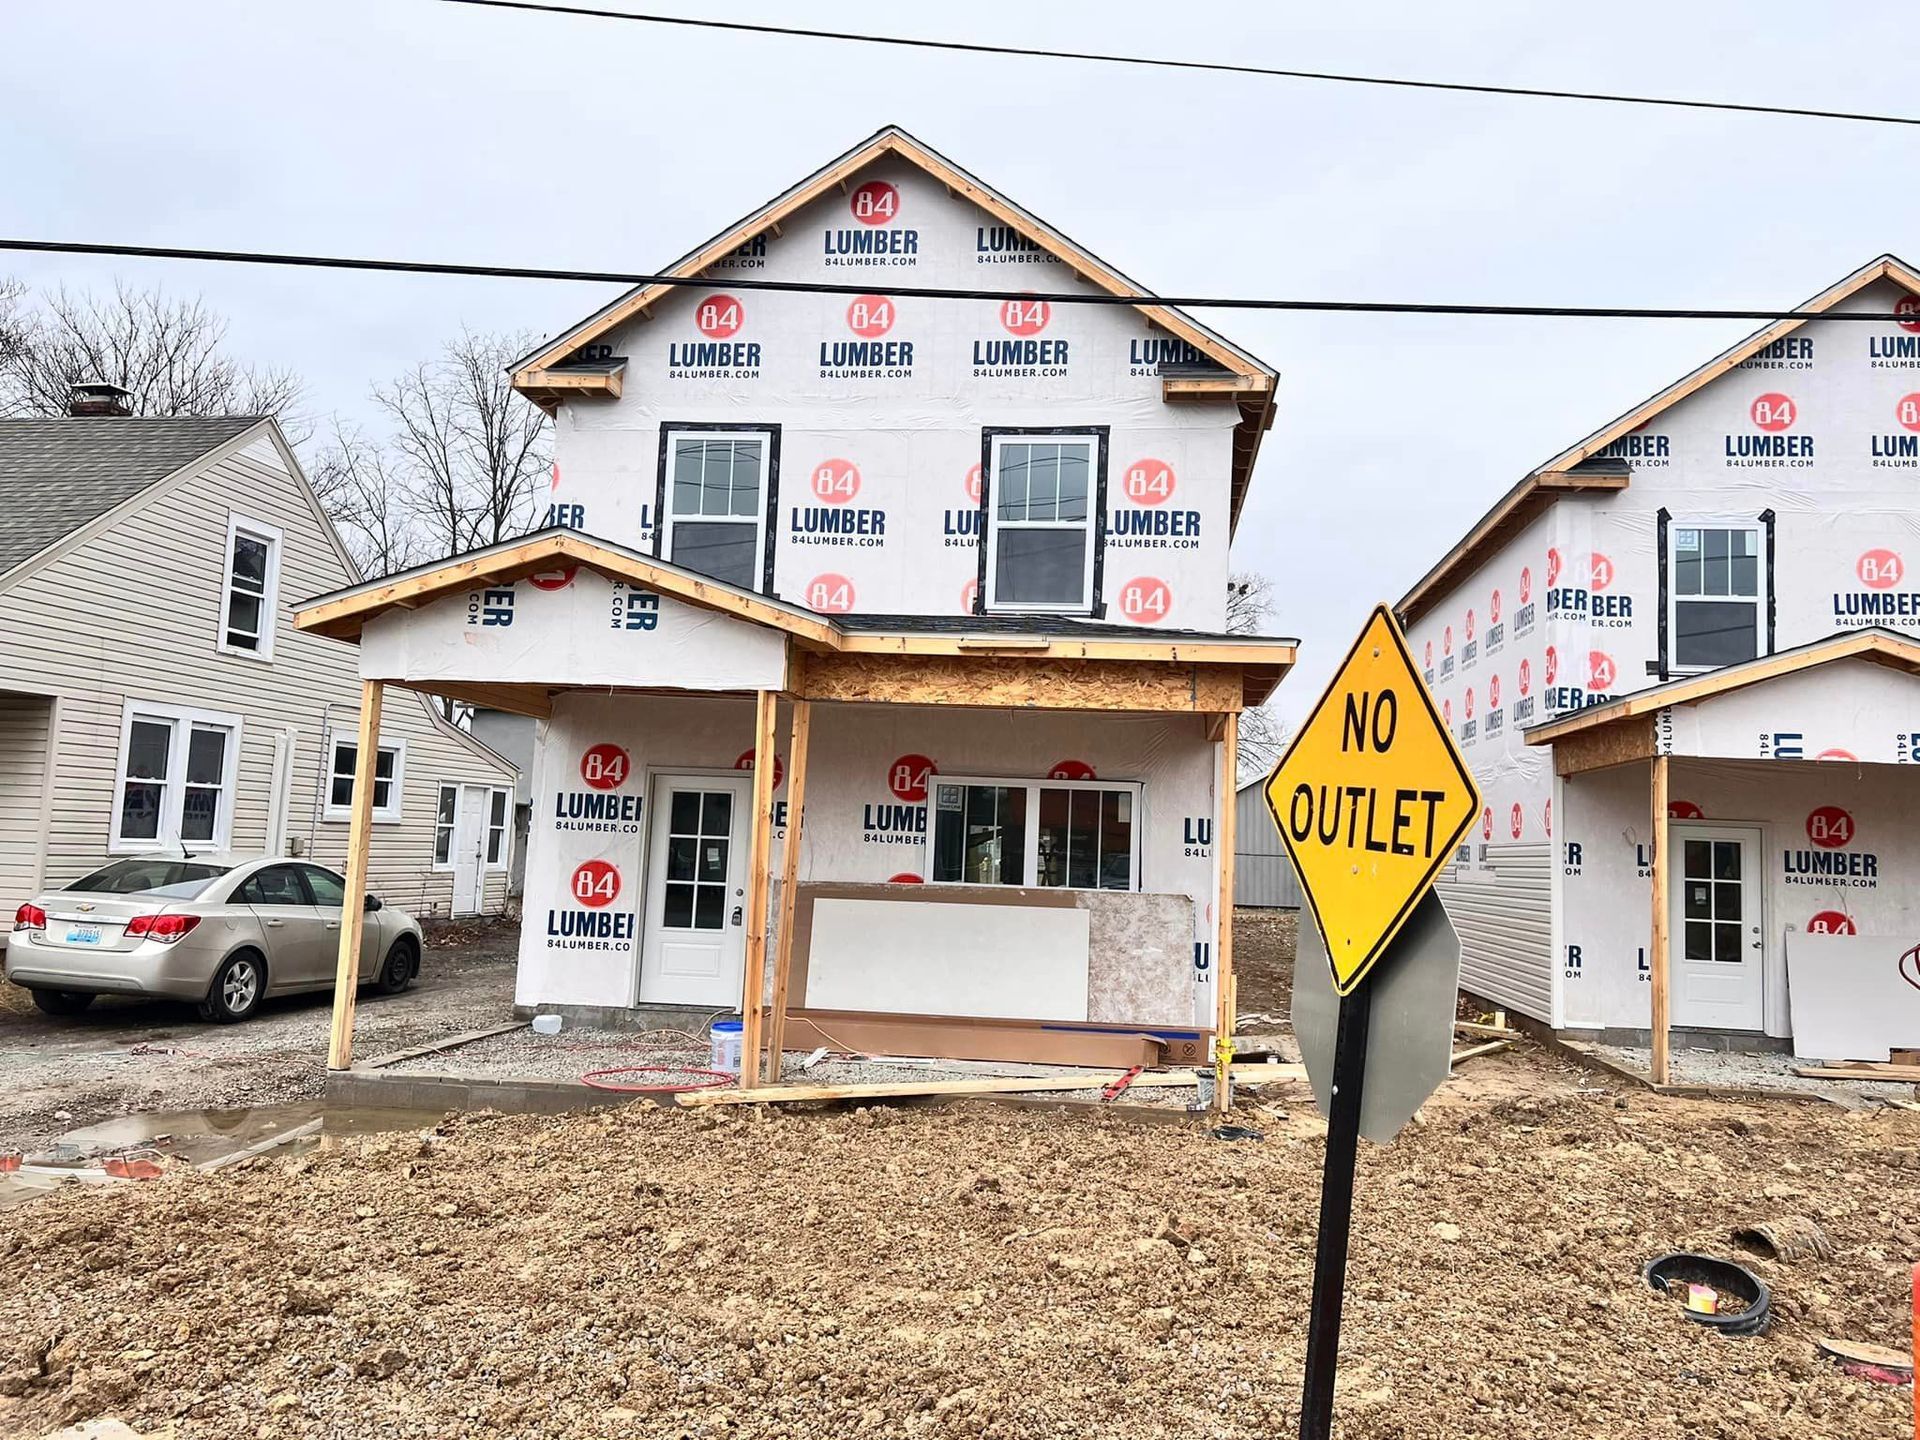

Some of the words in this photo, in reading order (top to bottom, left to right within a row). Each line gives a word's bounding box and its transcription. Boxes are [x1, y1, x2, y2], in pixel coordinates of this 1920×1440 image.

[856, 191, 894, 217] 84
[824, 229, 918, 254] LUMBER
[825, 257, 917, 266] 84LUMBER.COM
[977, 254, 1065, 264] 84LUMBER.CO
[701, 304, 738, 330] 84
[852, 303, 889, 329] 84
[1006, 301, 1044, 327] 84
[669, 343, 761, 367] LUMBER
[820, 342, 913, 367] LUMBER
[973, 340, 1069, 365] LUMBER
[1870, 337, 1920, 358] LUM
[669, 370, 760, 379] 84LUMBER.COM
[820, 369, 912, 379] 84LUMBER.COM
[973, 367, 1067, 377] 84LUMBER.COM
[1755, 402, 1791, 424] 84
[1901, 401, 1920, 424] 8
[1725, 435, 1814, 457] LUMBER
[1726, 459, 1814, 468] 84LUMBER.COM
[817, 468, 854, 496] 84
[1129, 469, 1168, 496] 84
[791, 507, 886, 535] LUMBER
[791, 535, 885, 547] 84LUMBER.COM
[1862, 558, 1898, 581] 84
[812, 583, 849, 610] 84
[1125, 587, 1165, 614] 84
[1342, 689, 1397, 753] NO
[585, 754, 623, 781] 84
[894, 765, 932, 793] 84
[1290, 783, 1445, 858] OUTLET
[1811, 818, 1849, 840] 84
[1784, 850, 1878, 877] LUMBER
[577, 871, 615, 899] 84
[1785, 876, 1878, 889] 84LUMBER.COM
